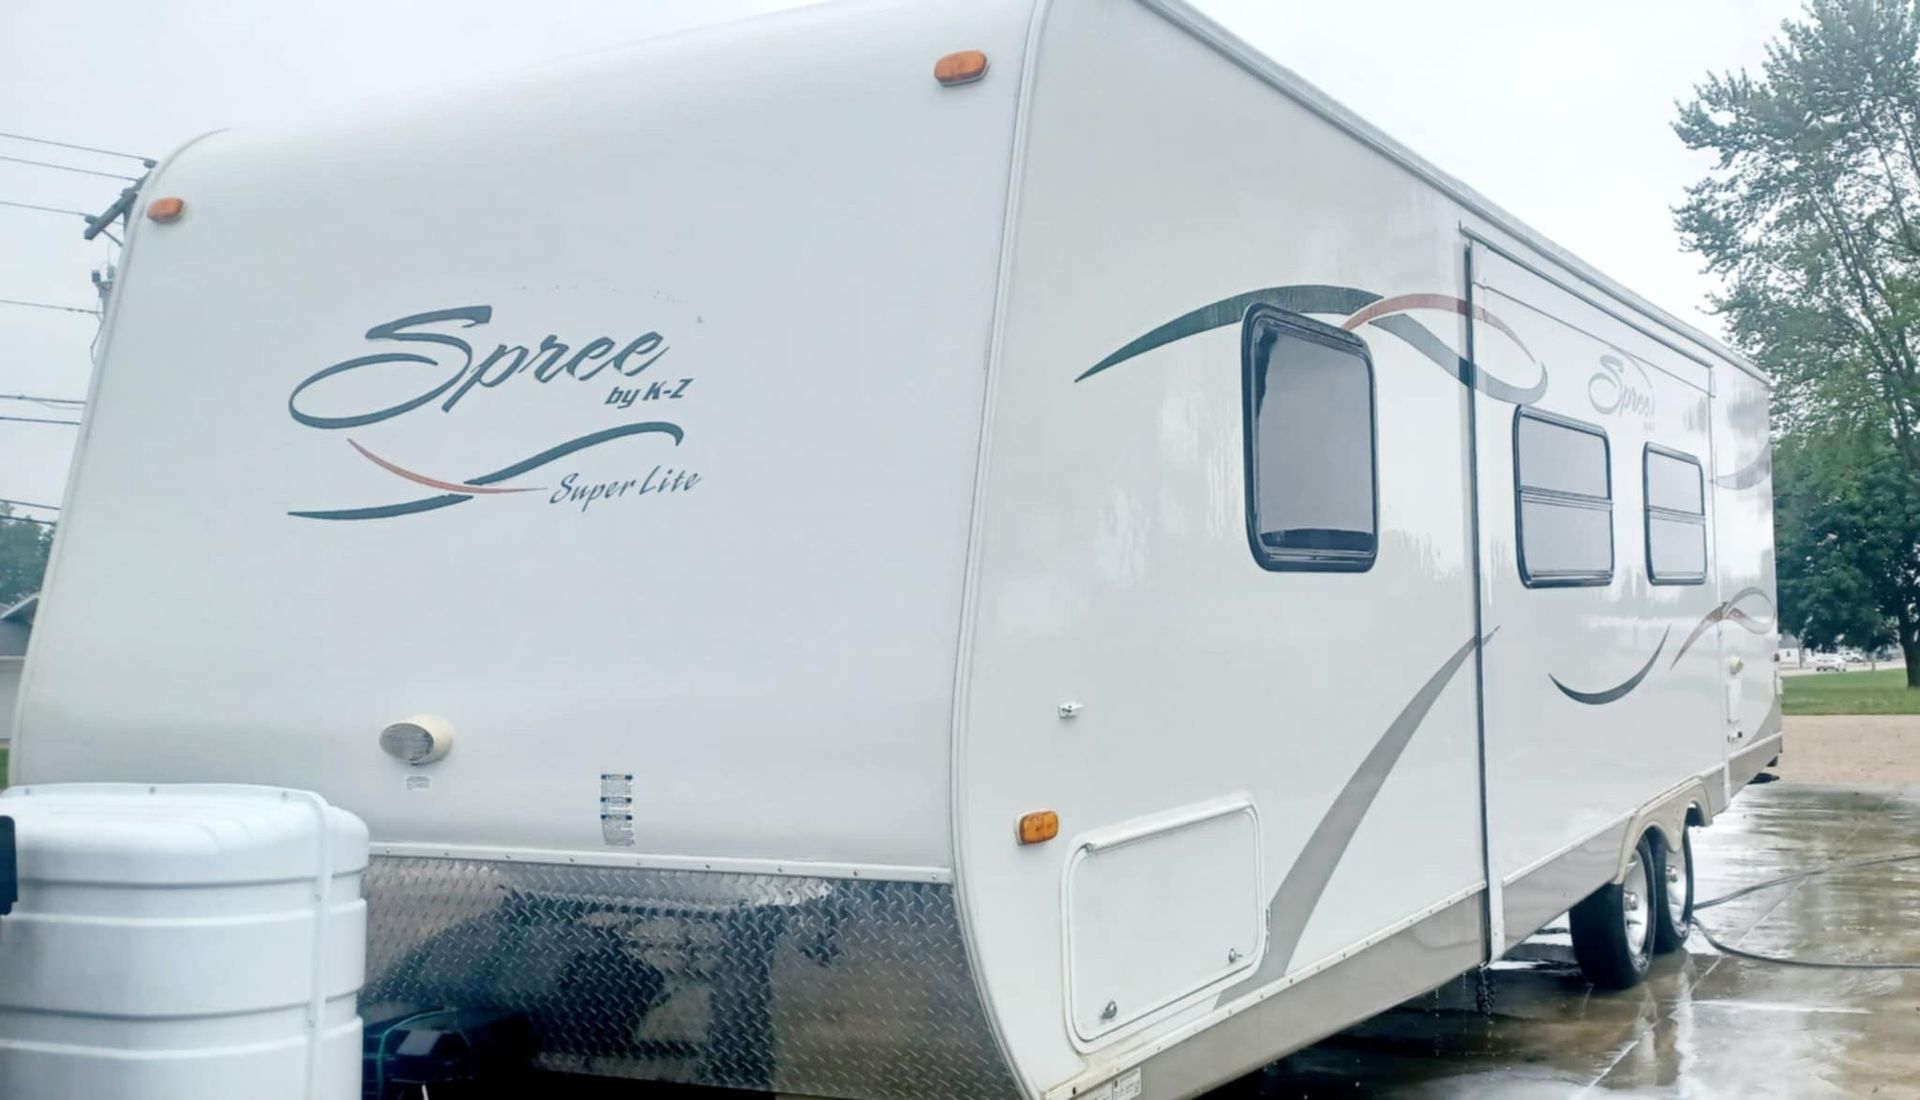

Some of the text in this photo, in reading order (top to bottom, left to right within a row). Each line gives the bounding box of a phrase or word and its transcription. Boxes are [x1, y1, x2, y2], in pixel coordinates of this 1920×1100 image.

[288, 305, 670, 429] Spree
[604, 378, 694, 409] by K-Z
